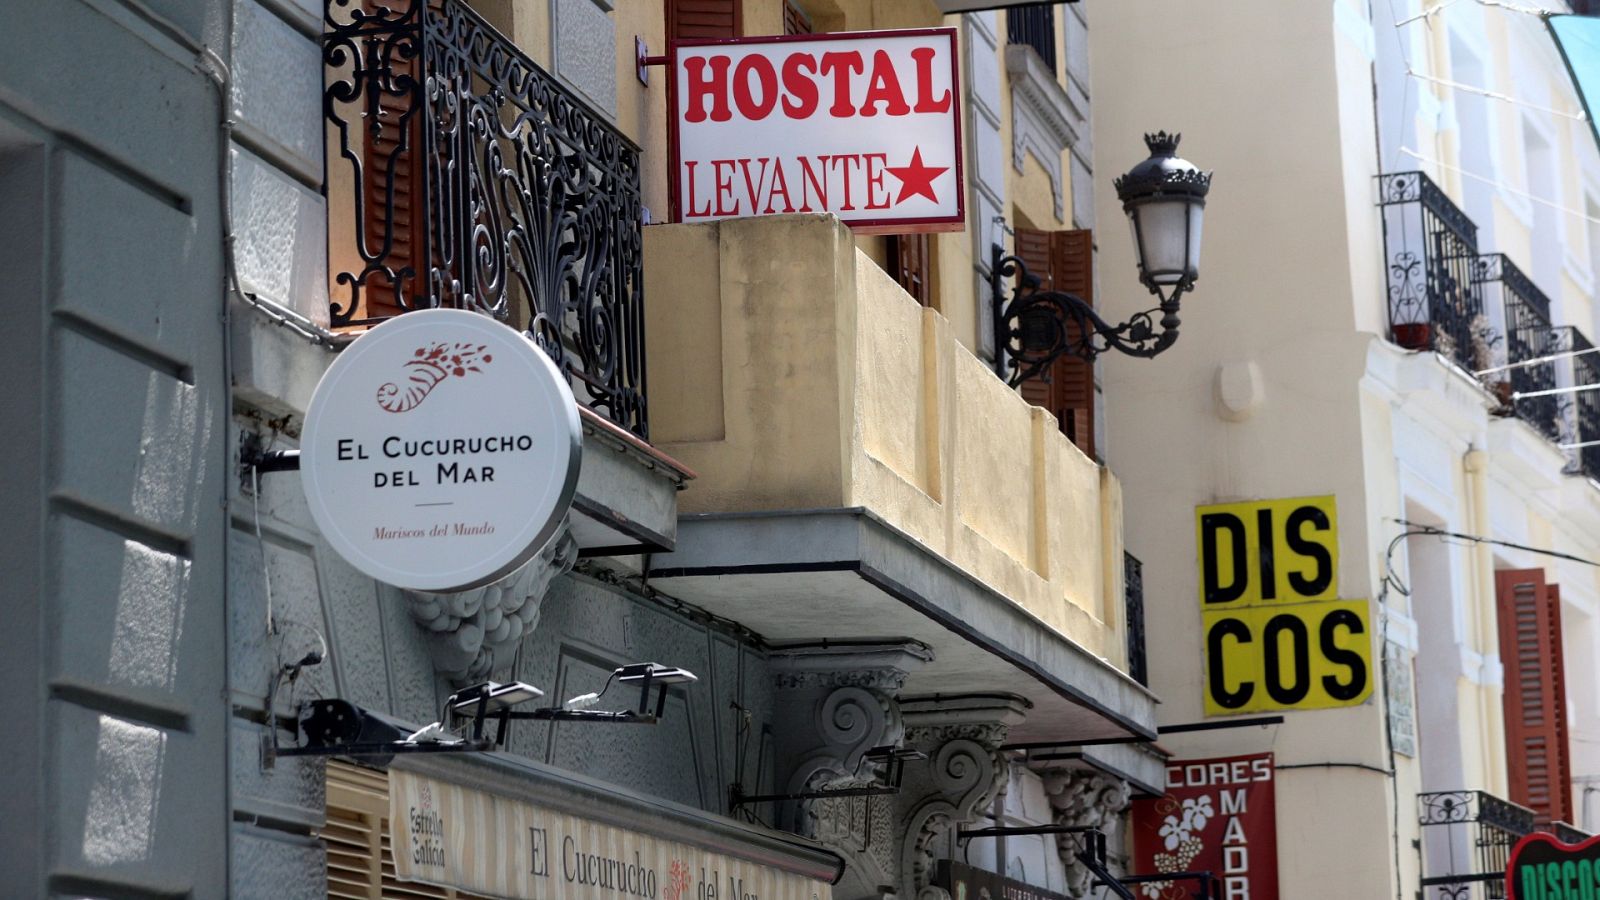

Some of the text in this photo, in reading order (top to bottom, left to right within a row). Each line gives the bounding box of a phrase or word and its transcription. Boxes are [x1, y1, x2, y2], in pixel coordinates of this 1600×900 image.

[683, 47, 951, 123] HOSTAL
[684, 153, 891, 217] LEVANTE
[372, 522, 495, 541] Mariscos del Mundo
[1201, 505, 1332, 604] DIS
[1207, 609, 1367, 709] COS
[410, 806, 444, 838] Estrella
[412, 836, 446, 868] Galicia
[529, 826, 550, 877] El
[562, 835, 657, 900] Cucurucho
